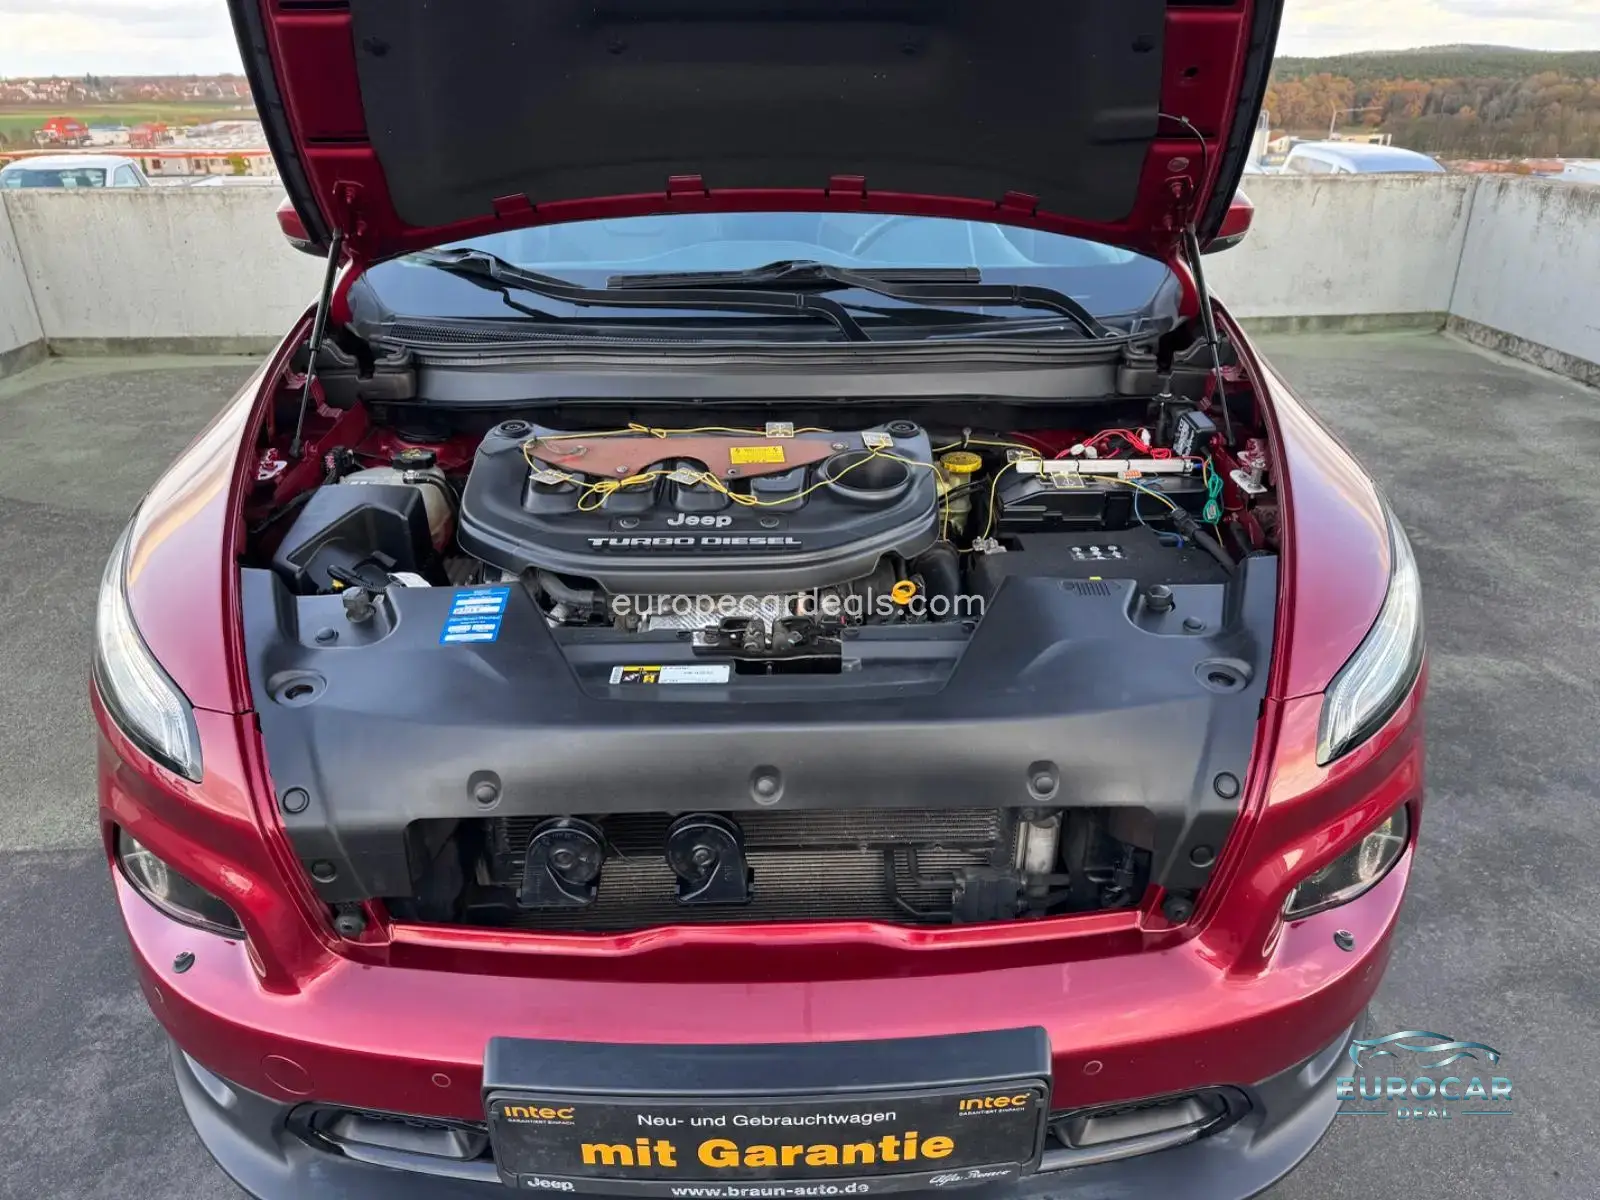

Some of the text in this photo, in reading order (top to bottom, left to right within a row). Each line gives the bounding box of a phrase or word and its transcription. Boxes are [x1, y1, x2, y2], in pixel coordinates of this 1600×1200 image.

[667, 513, 732, 527] Jeep
[588, 536, 802, 546] TURBO DIESEL
[637, 1111, 898, 1128] Neu- und Gebrauchtwagen
[580, 1131, 955, 1168] mit Garantie
[670, 1182, 870, 1197] www.braun-auto.de
